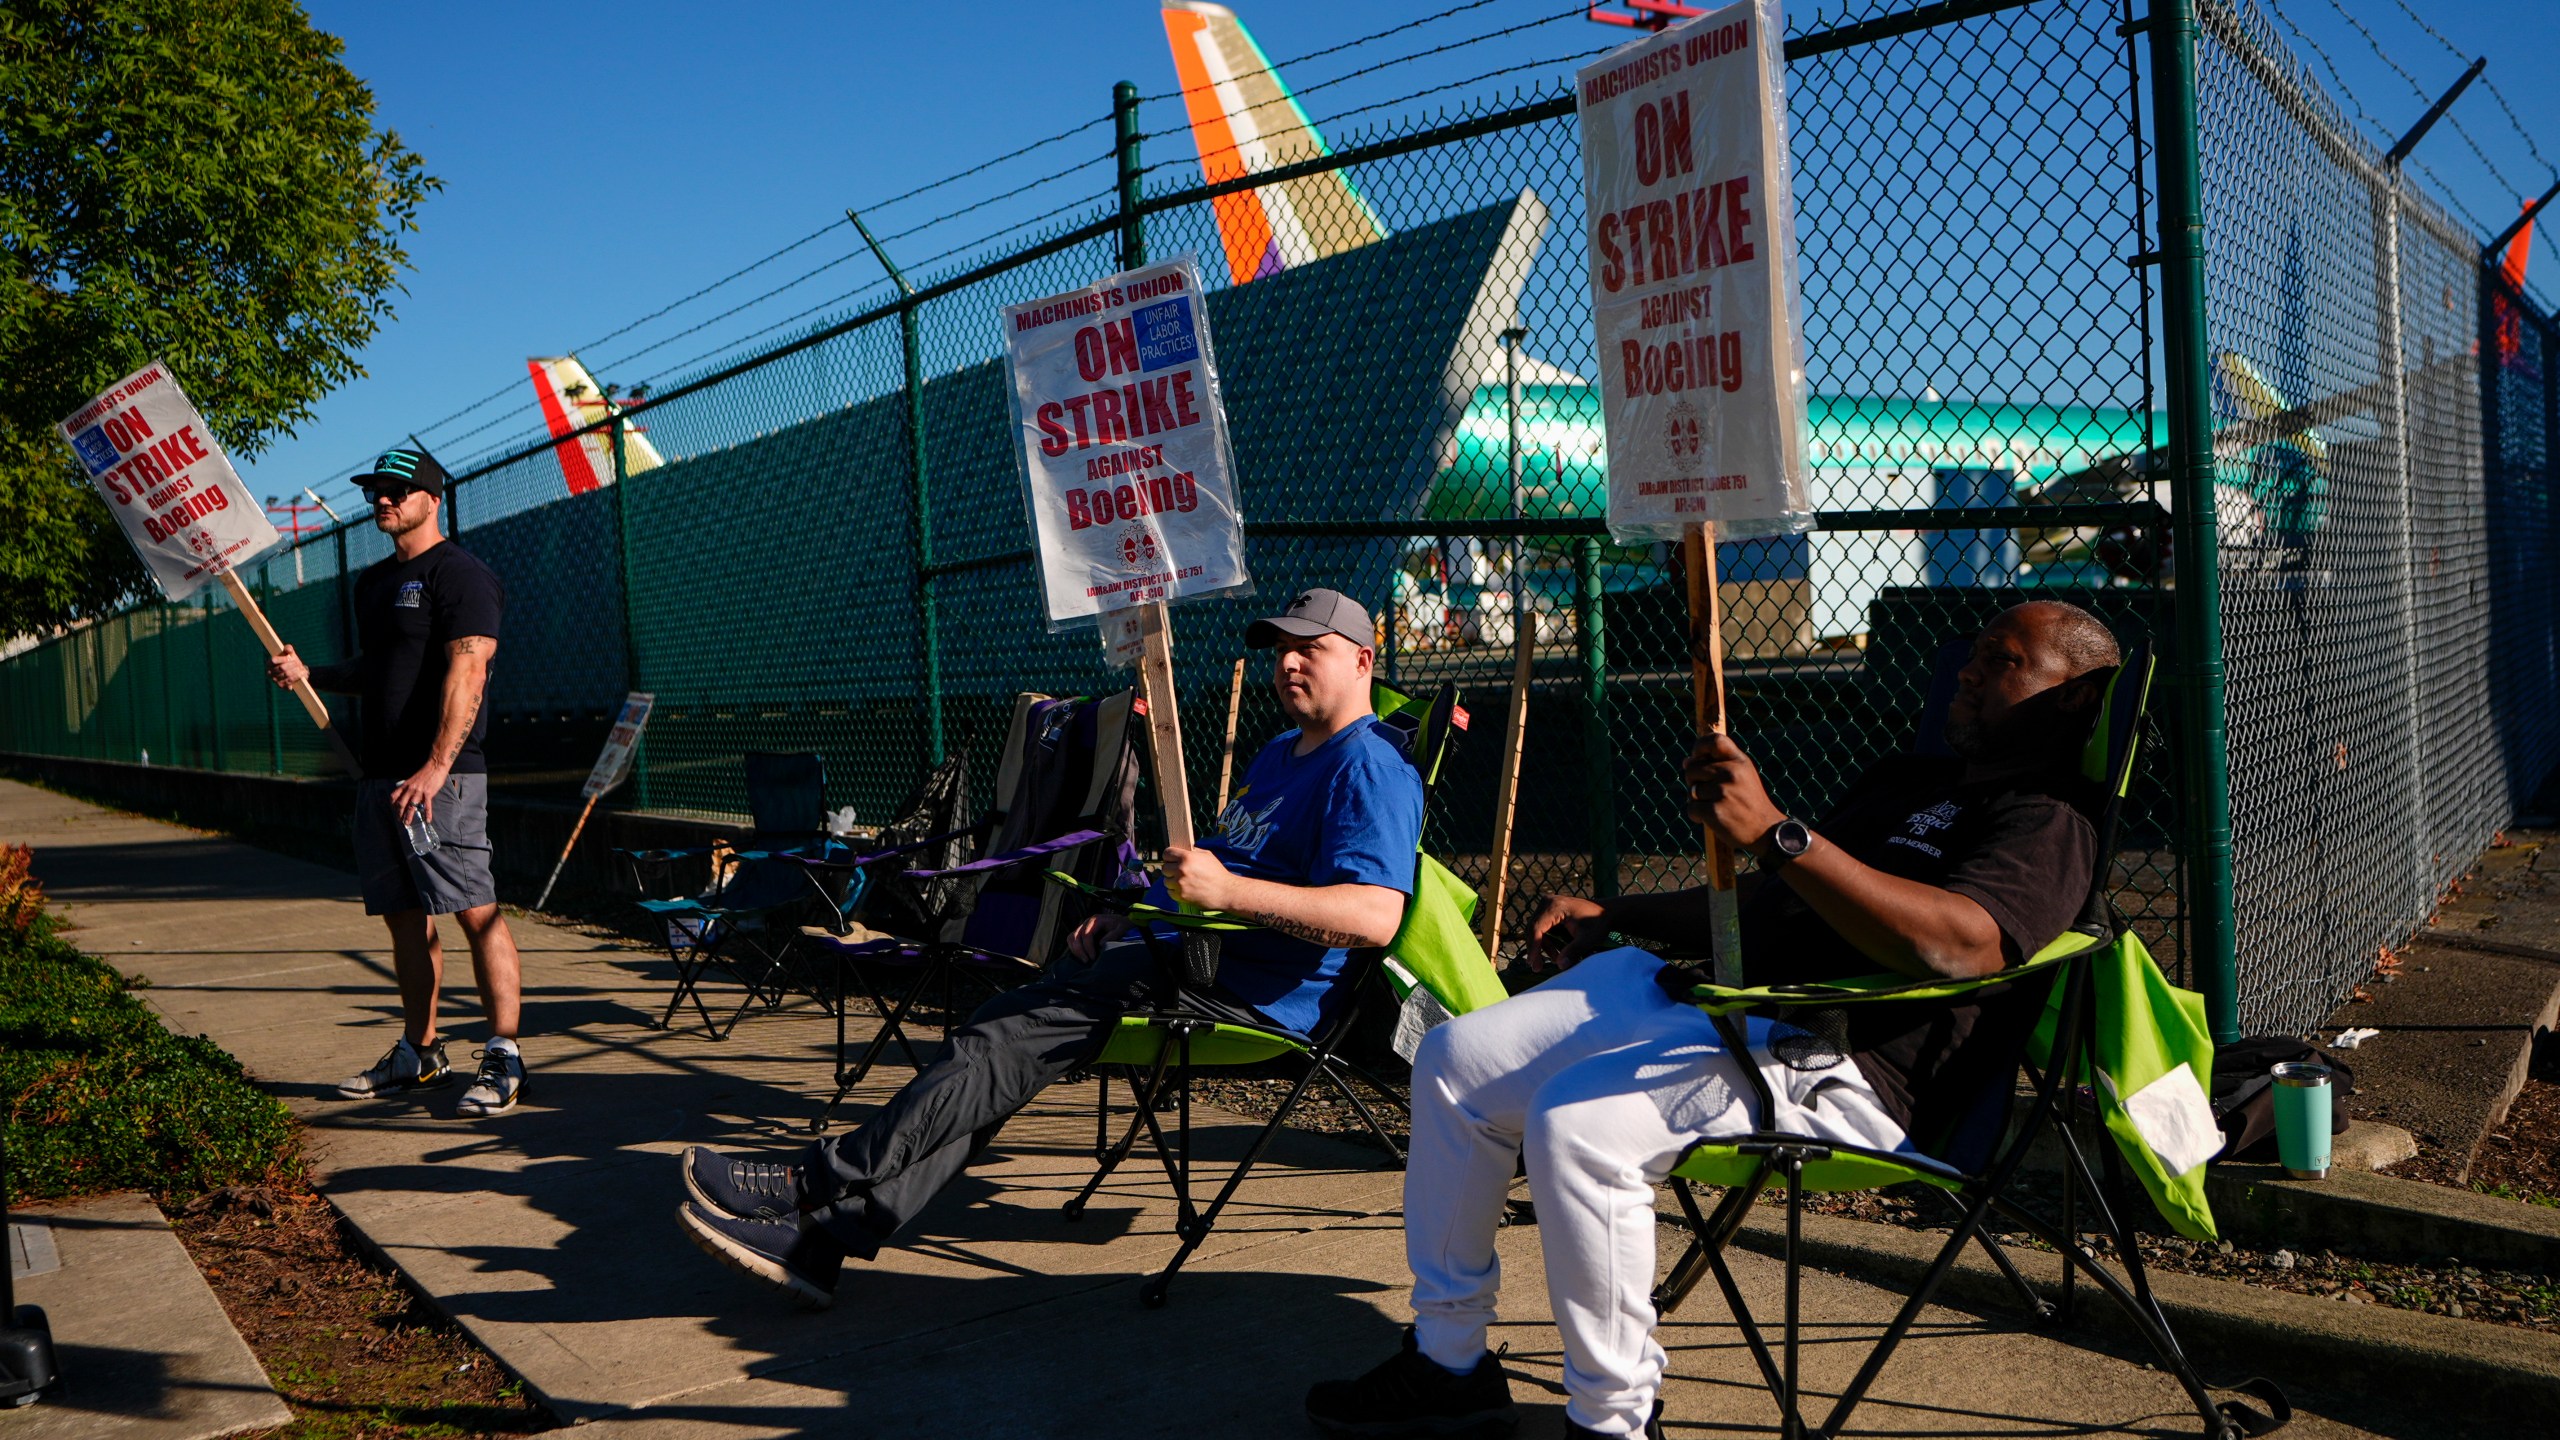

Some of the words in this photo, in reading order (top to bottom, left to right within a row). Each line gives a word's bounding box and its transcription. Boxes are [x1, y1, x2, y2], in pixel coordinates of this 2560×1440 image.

[1585, 46, 1682, 107] MACHINISTS
[1685, 19, 1748, 68] UNION
[1633, 90, 1692, 187] ON
[1598, 175, 1754, 293] STRIKE
[1016, 288, 1124, 332] MACHINISTS
[1128, 273, 1184, 302] UNION
[1145, 305, 1180, 327] UNFAIR
[1641, 284, 1712, 330] AGAINST
[1074, 317, 1140, 382] ON
[1141, 333, 1195, 360] PRACTICES!
[1150, 322, 1180, 341] LABOR
[1621, 327, 1742, 399] Boeing
[66, 390, 126, 436] MACHINISTS
[123, 368, 162, 397] UNION
[1037, 370, 1200, 457] STRIKE
[103, 405, 154, 453] ON
[104, 424, 209, 506] STRIKE
[1087, 443, 1163, 481] AGAINST
[1669, 478, 1704, 494] DISTRICT
[1732, 474, 1747, 489] 751
[143, 483, 229, 545] Boeing
[146, 474, 194, 511] AGAINST
[1066, 470, 1198, 531] Boeing
[223, 543, 241, 556] LODGE
[1087, 582, 1121, 597] IAM&AW
[1123, 575, 1161, 590] DISTRICT
[1163, 570, 1188, 583] LOGE
[1189, 565, 1203, 577] 751
[1130, 587, 1163, 602] AFL-CIO
[1906, 840, 1942, 858] MEMBER
[1908, 823, 1930, 835] 751
